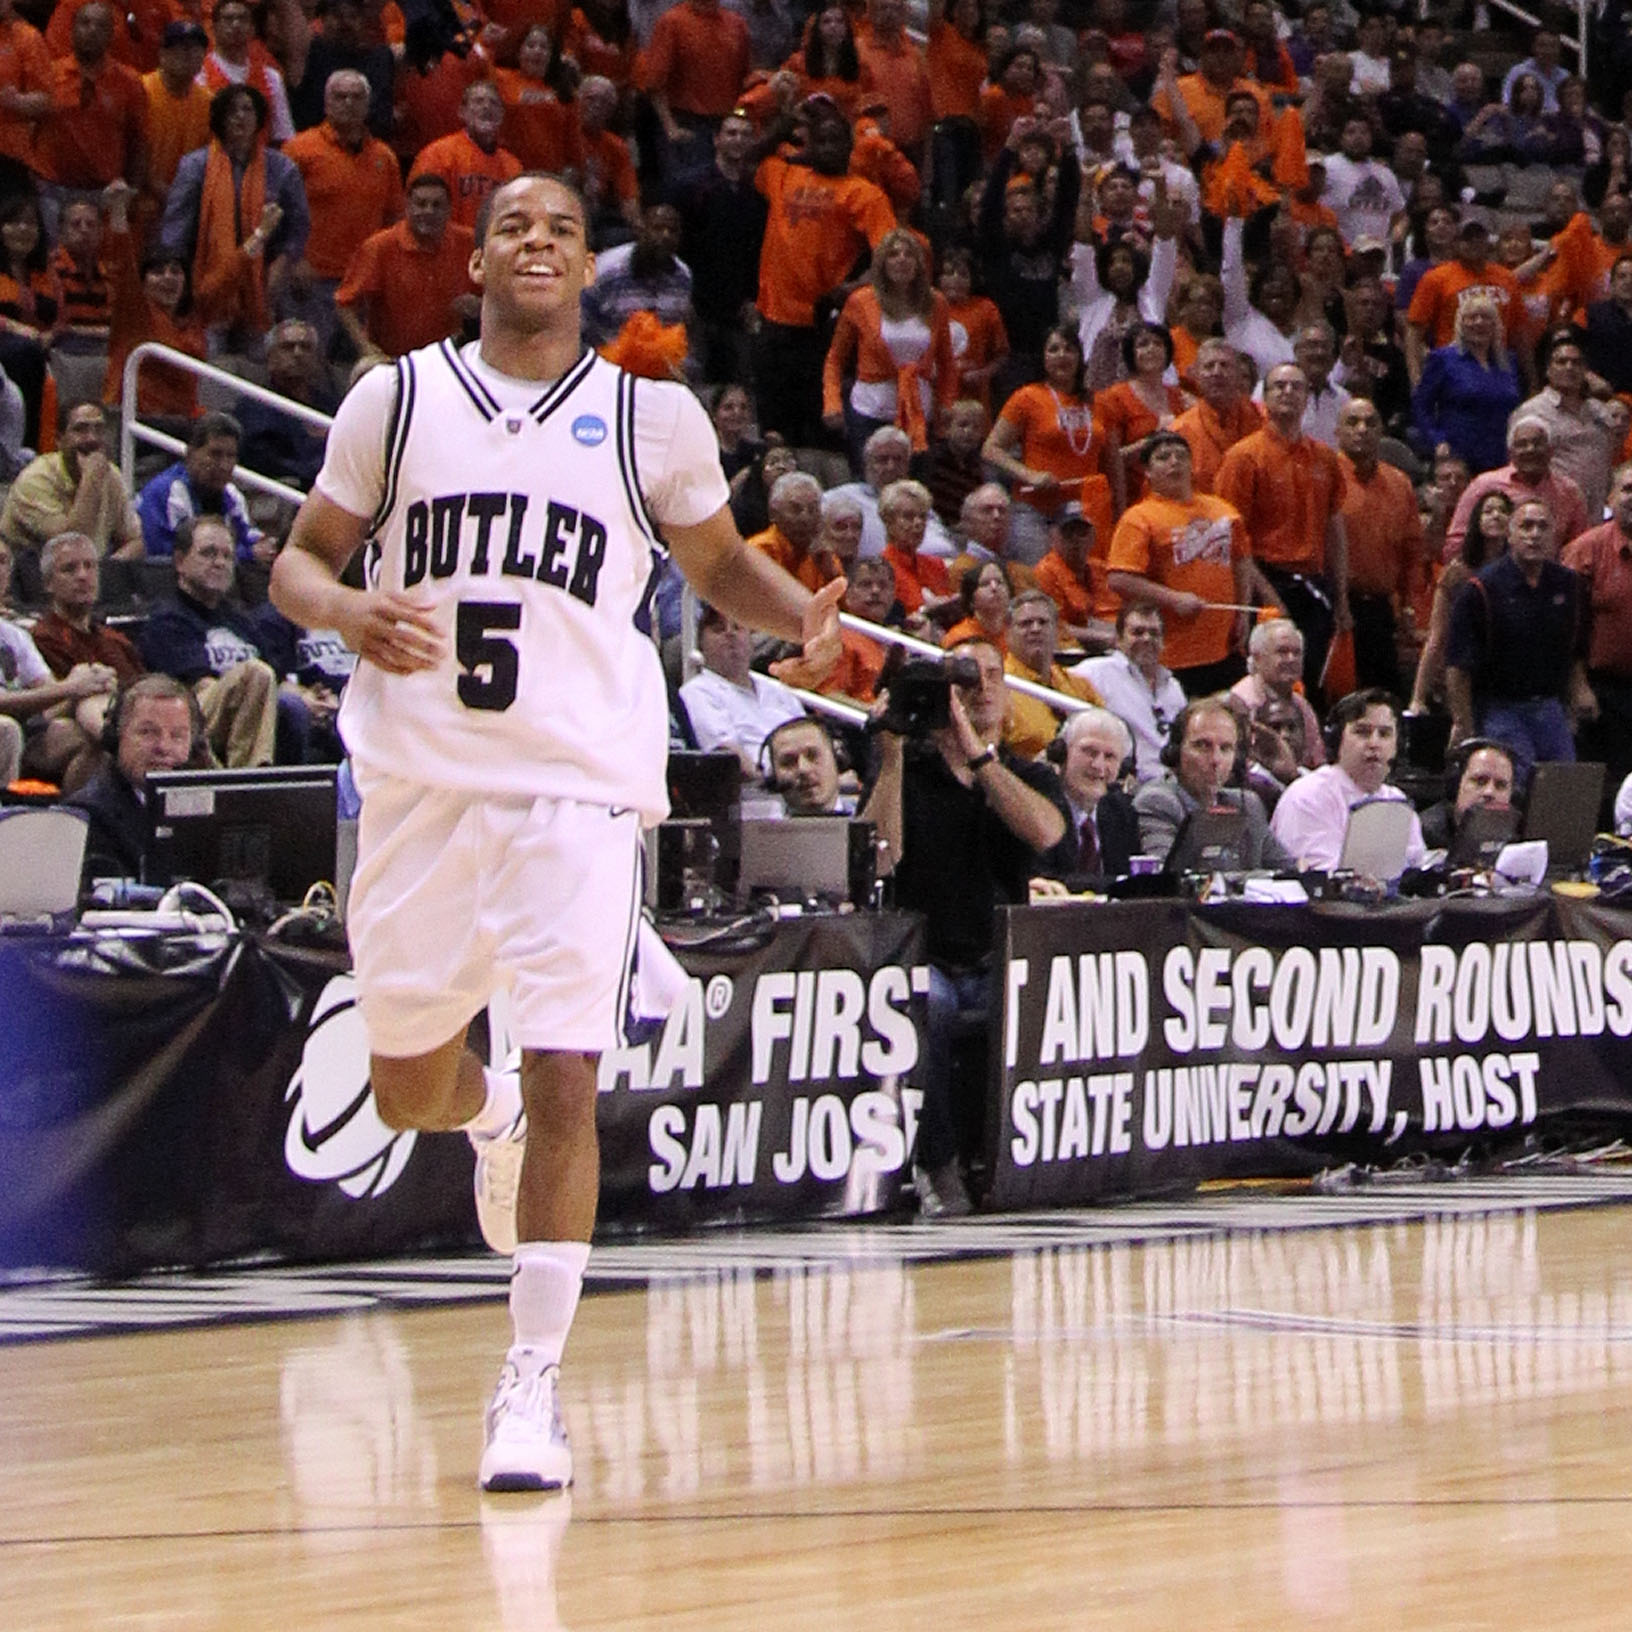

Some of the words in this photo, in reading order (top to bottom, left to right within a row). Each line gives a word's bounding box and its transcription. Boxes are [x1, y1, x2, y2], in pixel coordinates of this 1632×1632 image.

[403, 492, 608, 606] BUTLER
[455, 601, 523, 711] 5
[751, 965, 930, 1085] FIRS
[1040, 949, 1150, 1066] AND
[1161, 945, 1401, 1053] SECOND
[648, 1102, 763, 1193] SAN
[1010, 1073, 1133, 1167] STATE
[1142, 1059, 1410, 1148] UNIVERSITY,
[1421, 1052, 1540, 1133] HOST
